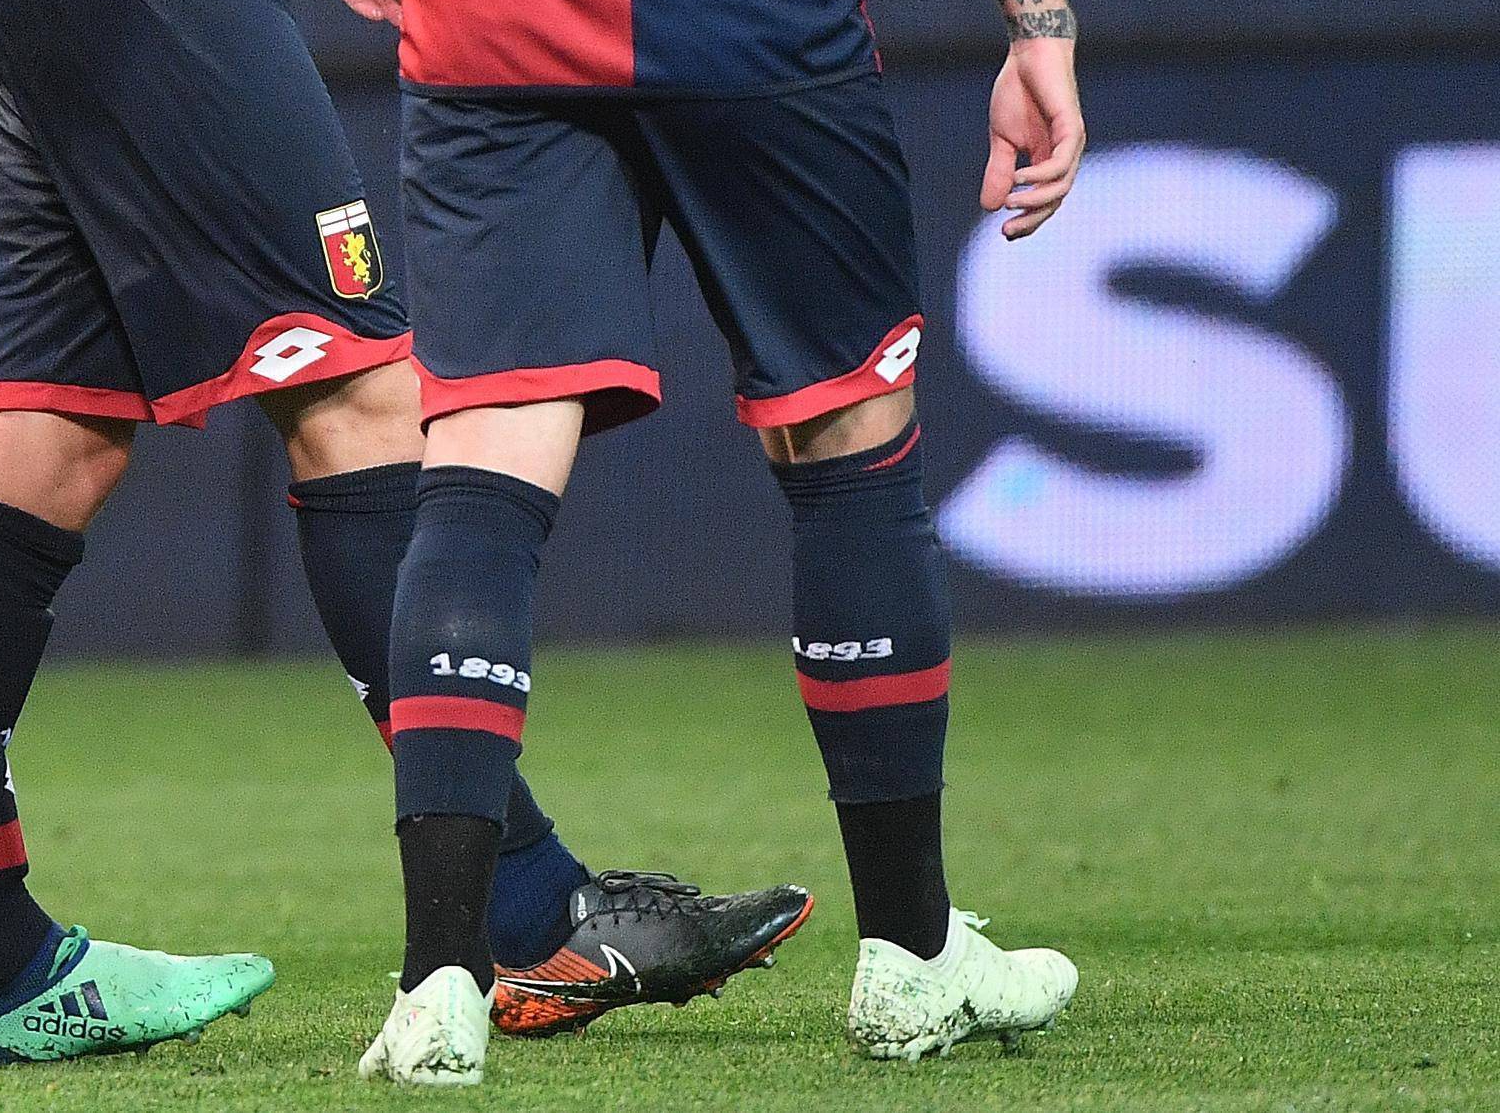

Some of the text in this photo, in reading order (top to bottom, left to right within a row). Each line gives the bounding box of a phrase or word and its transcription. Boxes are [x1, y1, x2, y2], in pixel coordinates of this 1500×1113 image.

[792, 636, 894, 661] 1893
[430, 652, 532, 693] 1893
[23, 1015, 129, 1042] adidas
